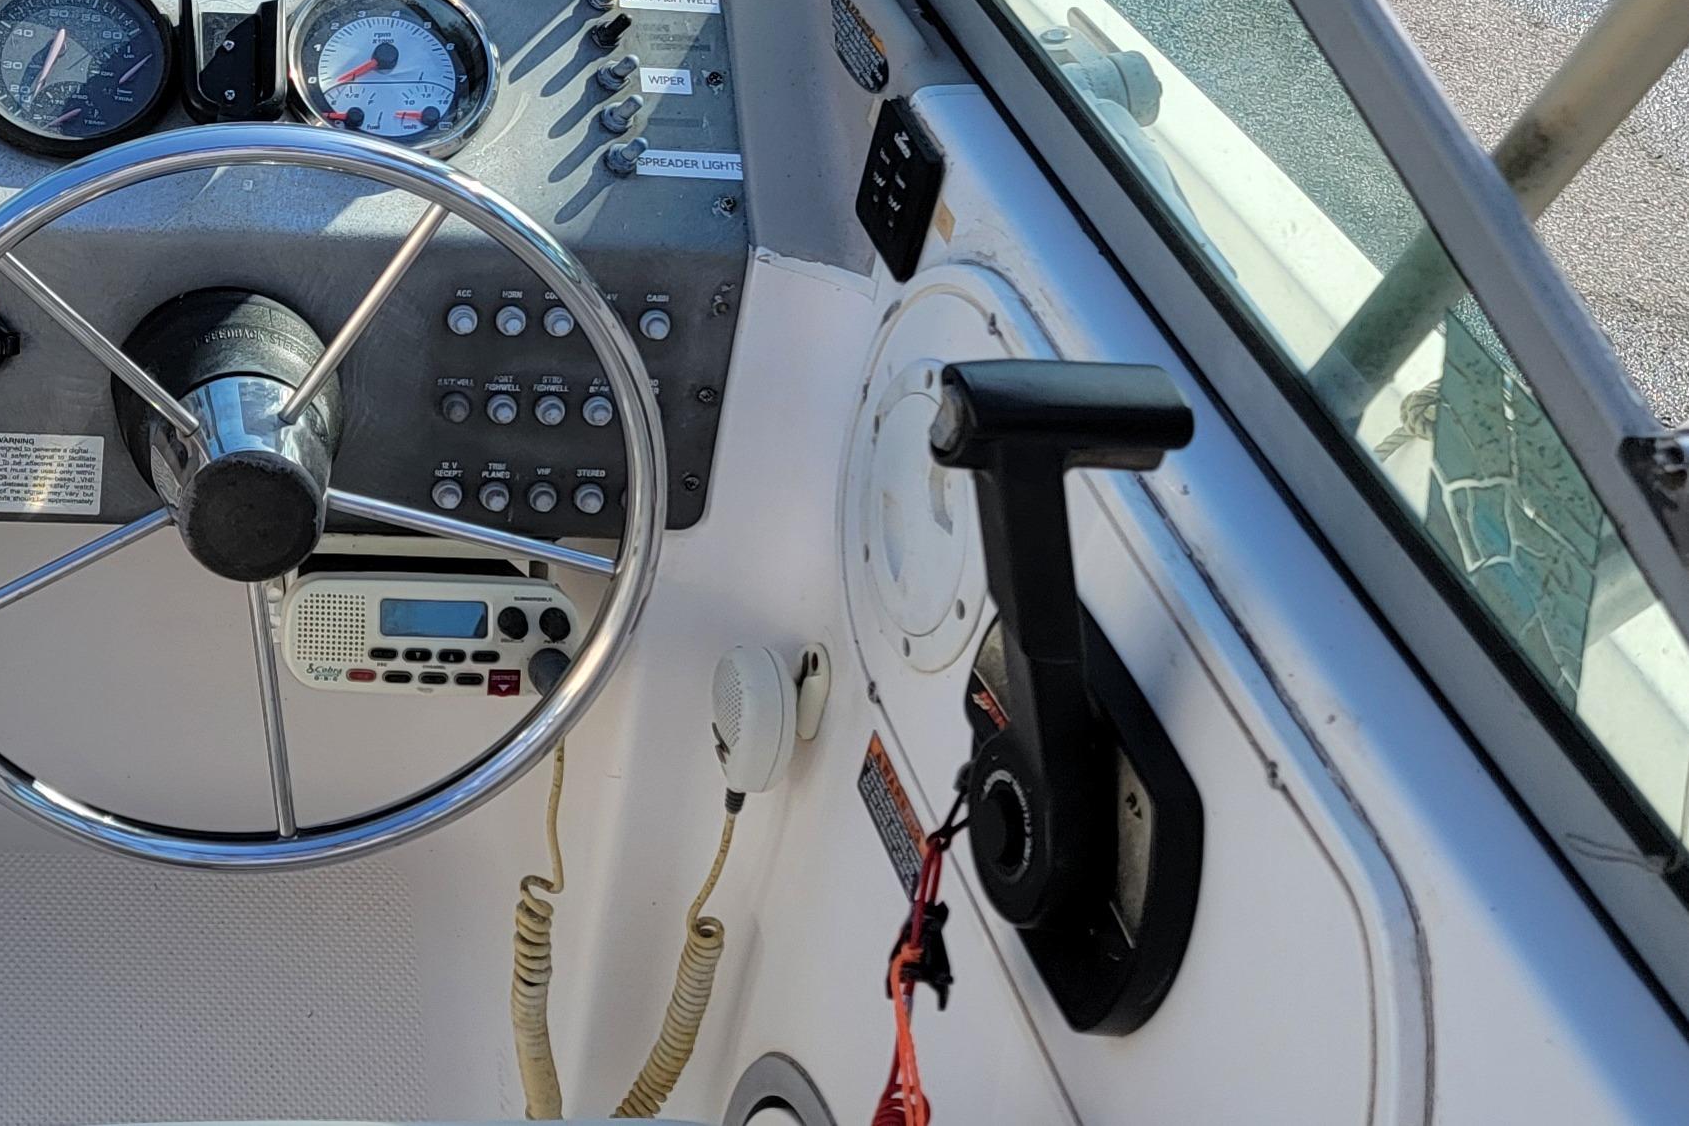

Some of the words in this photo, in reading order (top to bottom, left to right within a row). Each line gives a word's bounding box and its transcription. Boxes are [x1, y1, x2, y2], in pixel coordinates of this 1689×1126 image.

[49, 8, 69, 18] 50
[13, 29, 34, 38] 40
[2, 61, 23, 70] 30
[648, 75, 685, 86] WIPER
[638, 157, 699, 169] SPREADER
[701, 159, 743, 171] LIGHTS
[456, 289, 472, 297] ACC
